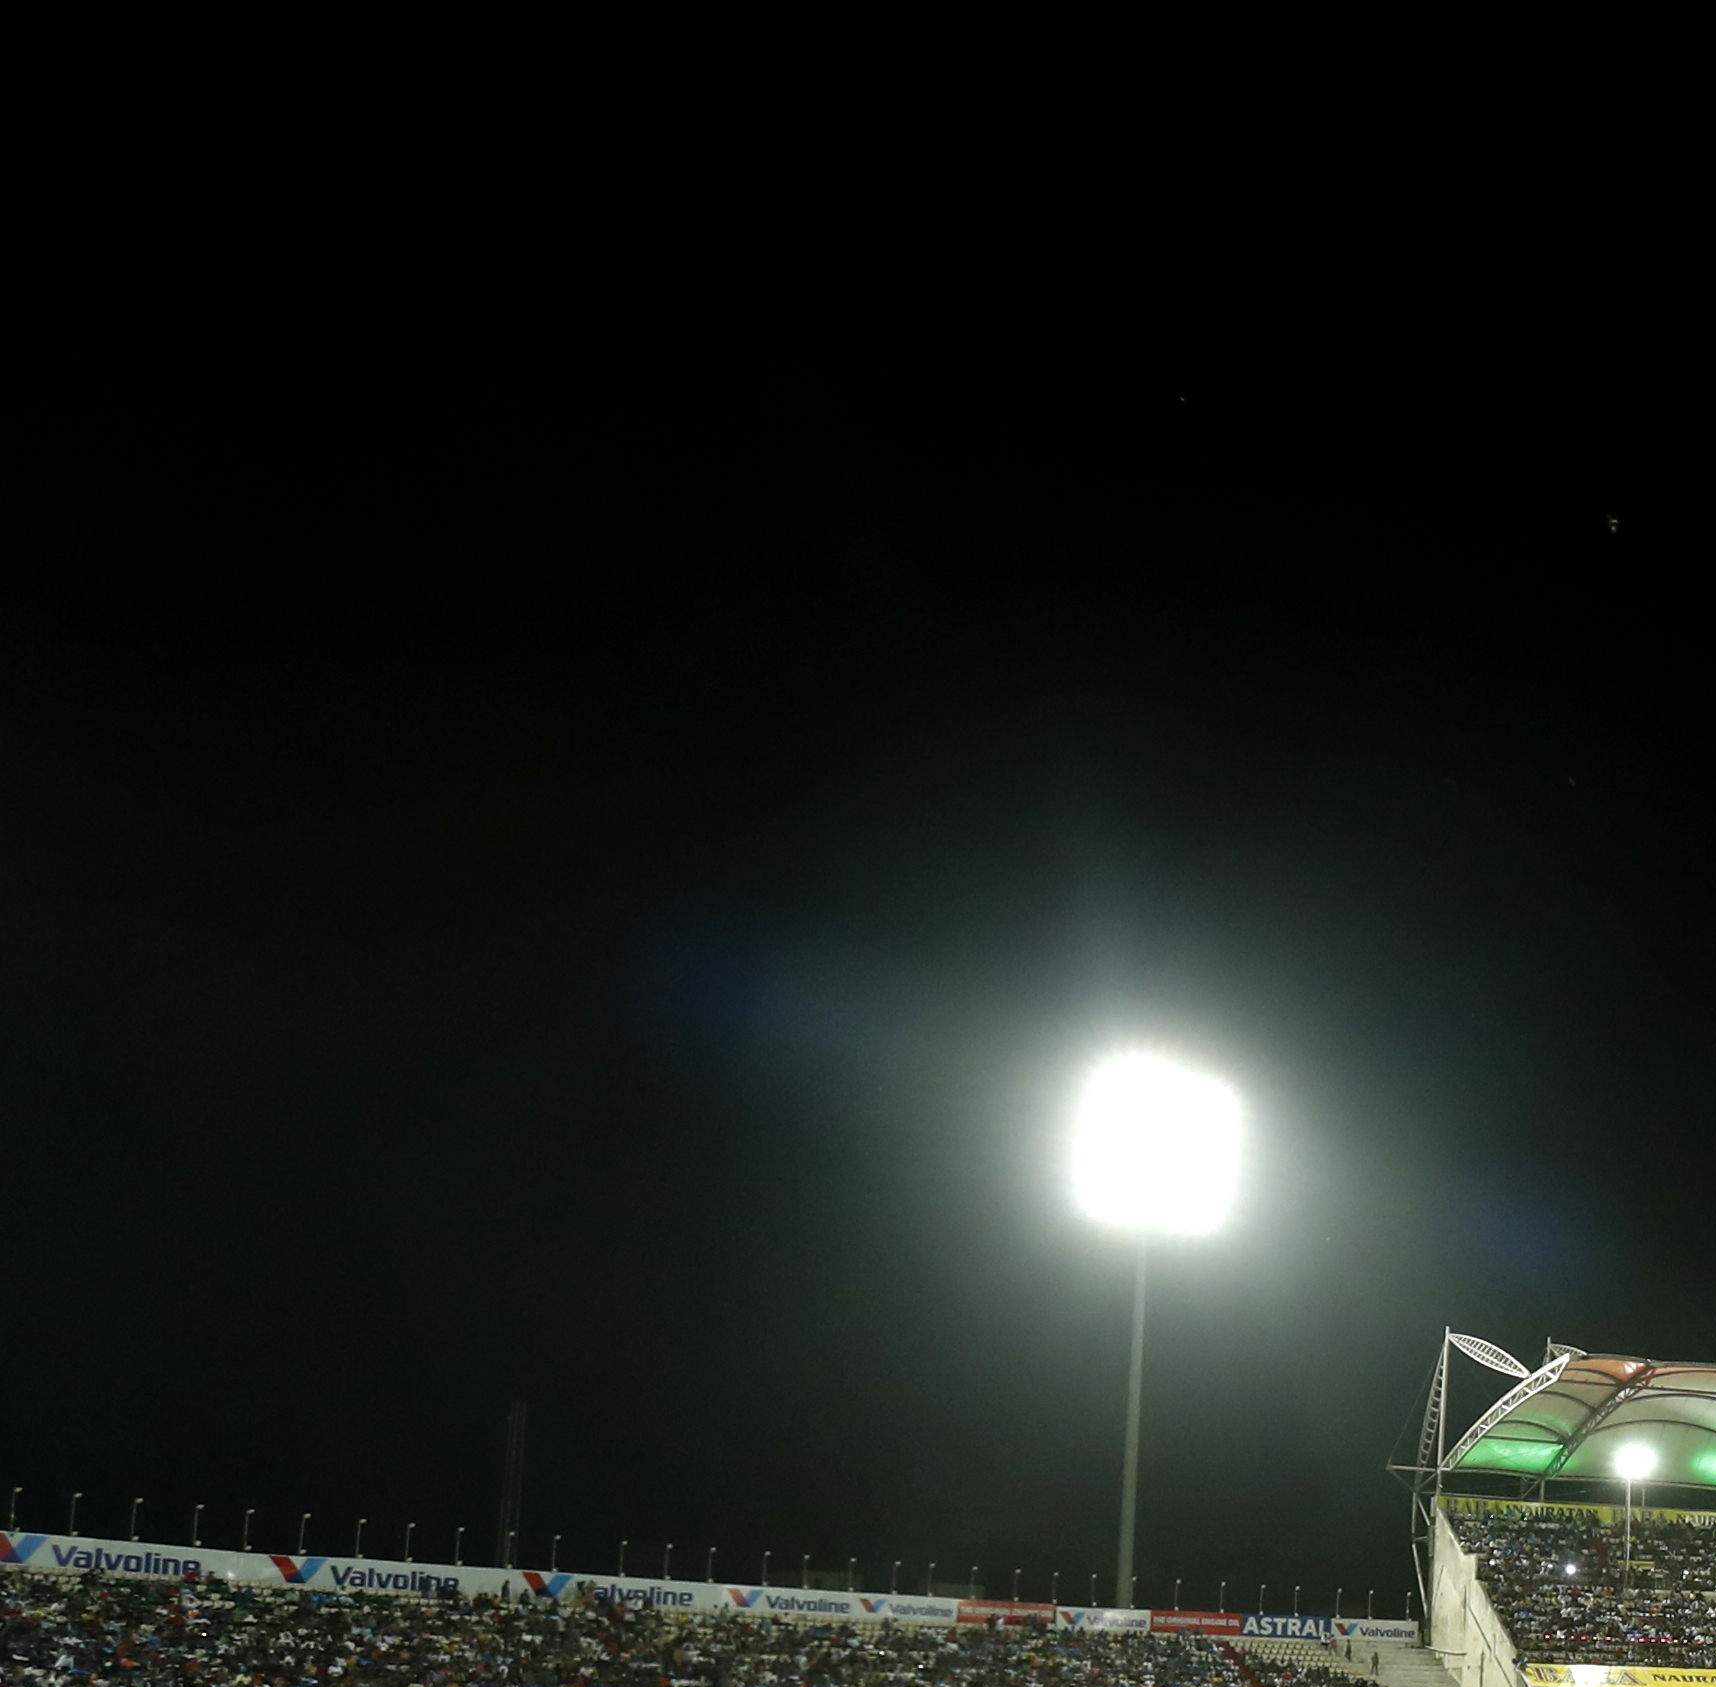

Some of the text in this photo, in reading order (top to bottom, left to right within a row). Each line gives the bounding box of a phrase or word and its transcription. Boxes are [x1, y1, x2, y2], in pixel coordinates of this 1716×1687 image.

[52, 1545, 201, 1577] Valvoline
[592, 1585, 693, 1607] alvoline
[765, 1595, 850, 1614] Valvoline
[1359, 1626, 1415, 1639] Valvoline
